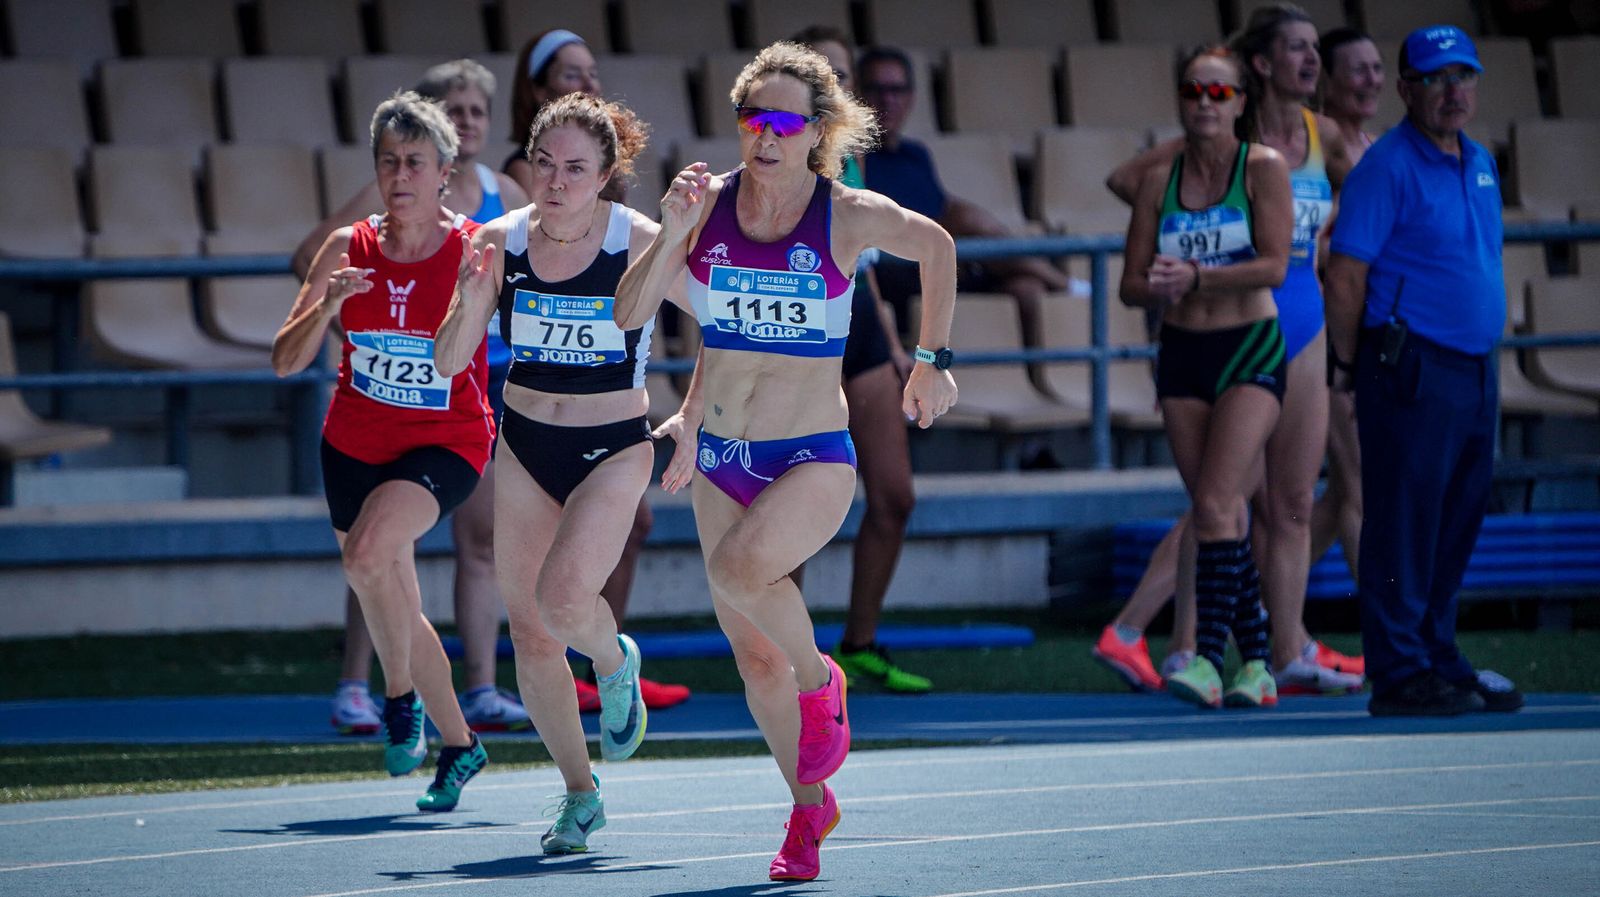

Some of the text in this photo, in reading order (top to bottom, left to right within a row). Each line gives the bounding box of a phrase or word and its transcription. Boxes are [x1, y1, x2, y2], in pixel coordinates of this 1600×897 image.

[1178, 230, 1221, 261] 997
[757, 275, 799, 285] LOTERÍAS
[726, 296, 808, 324] 1113
[539, 321, 594, 348] 776
[366, 353, 434, 385] 1123
